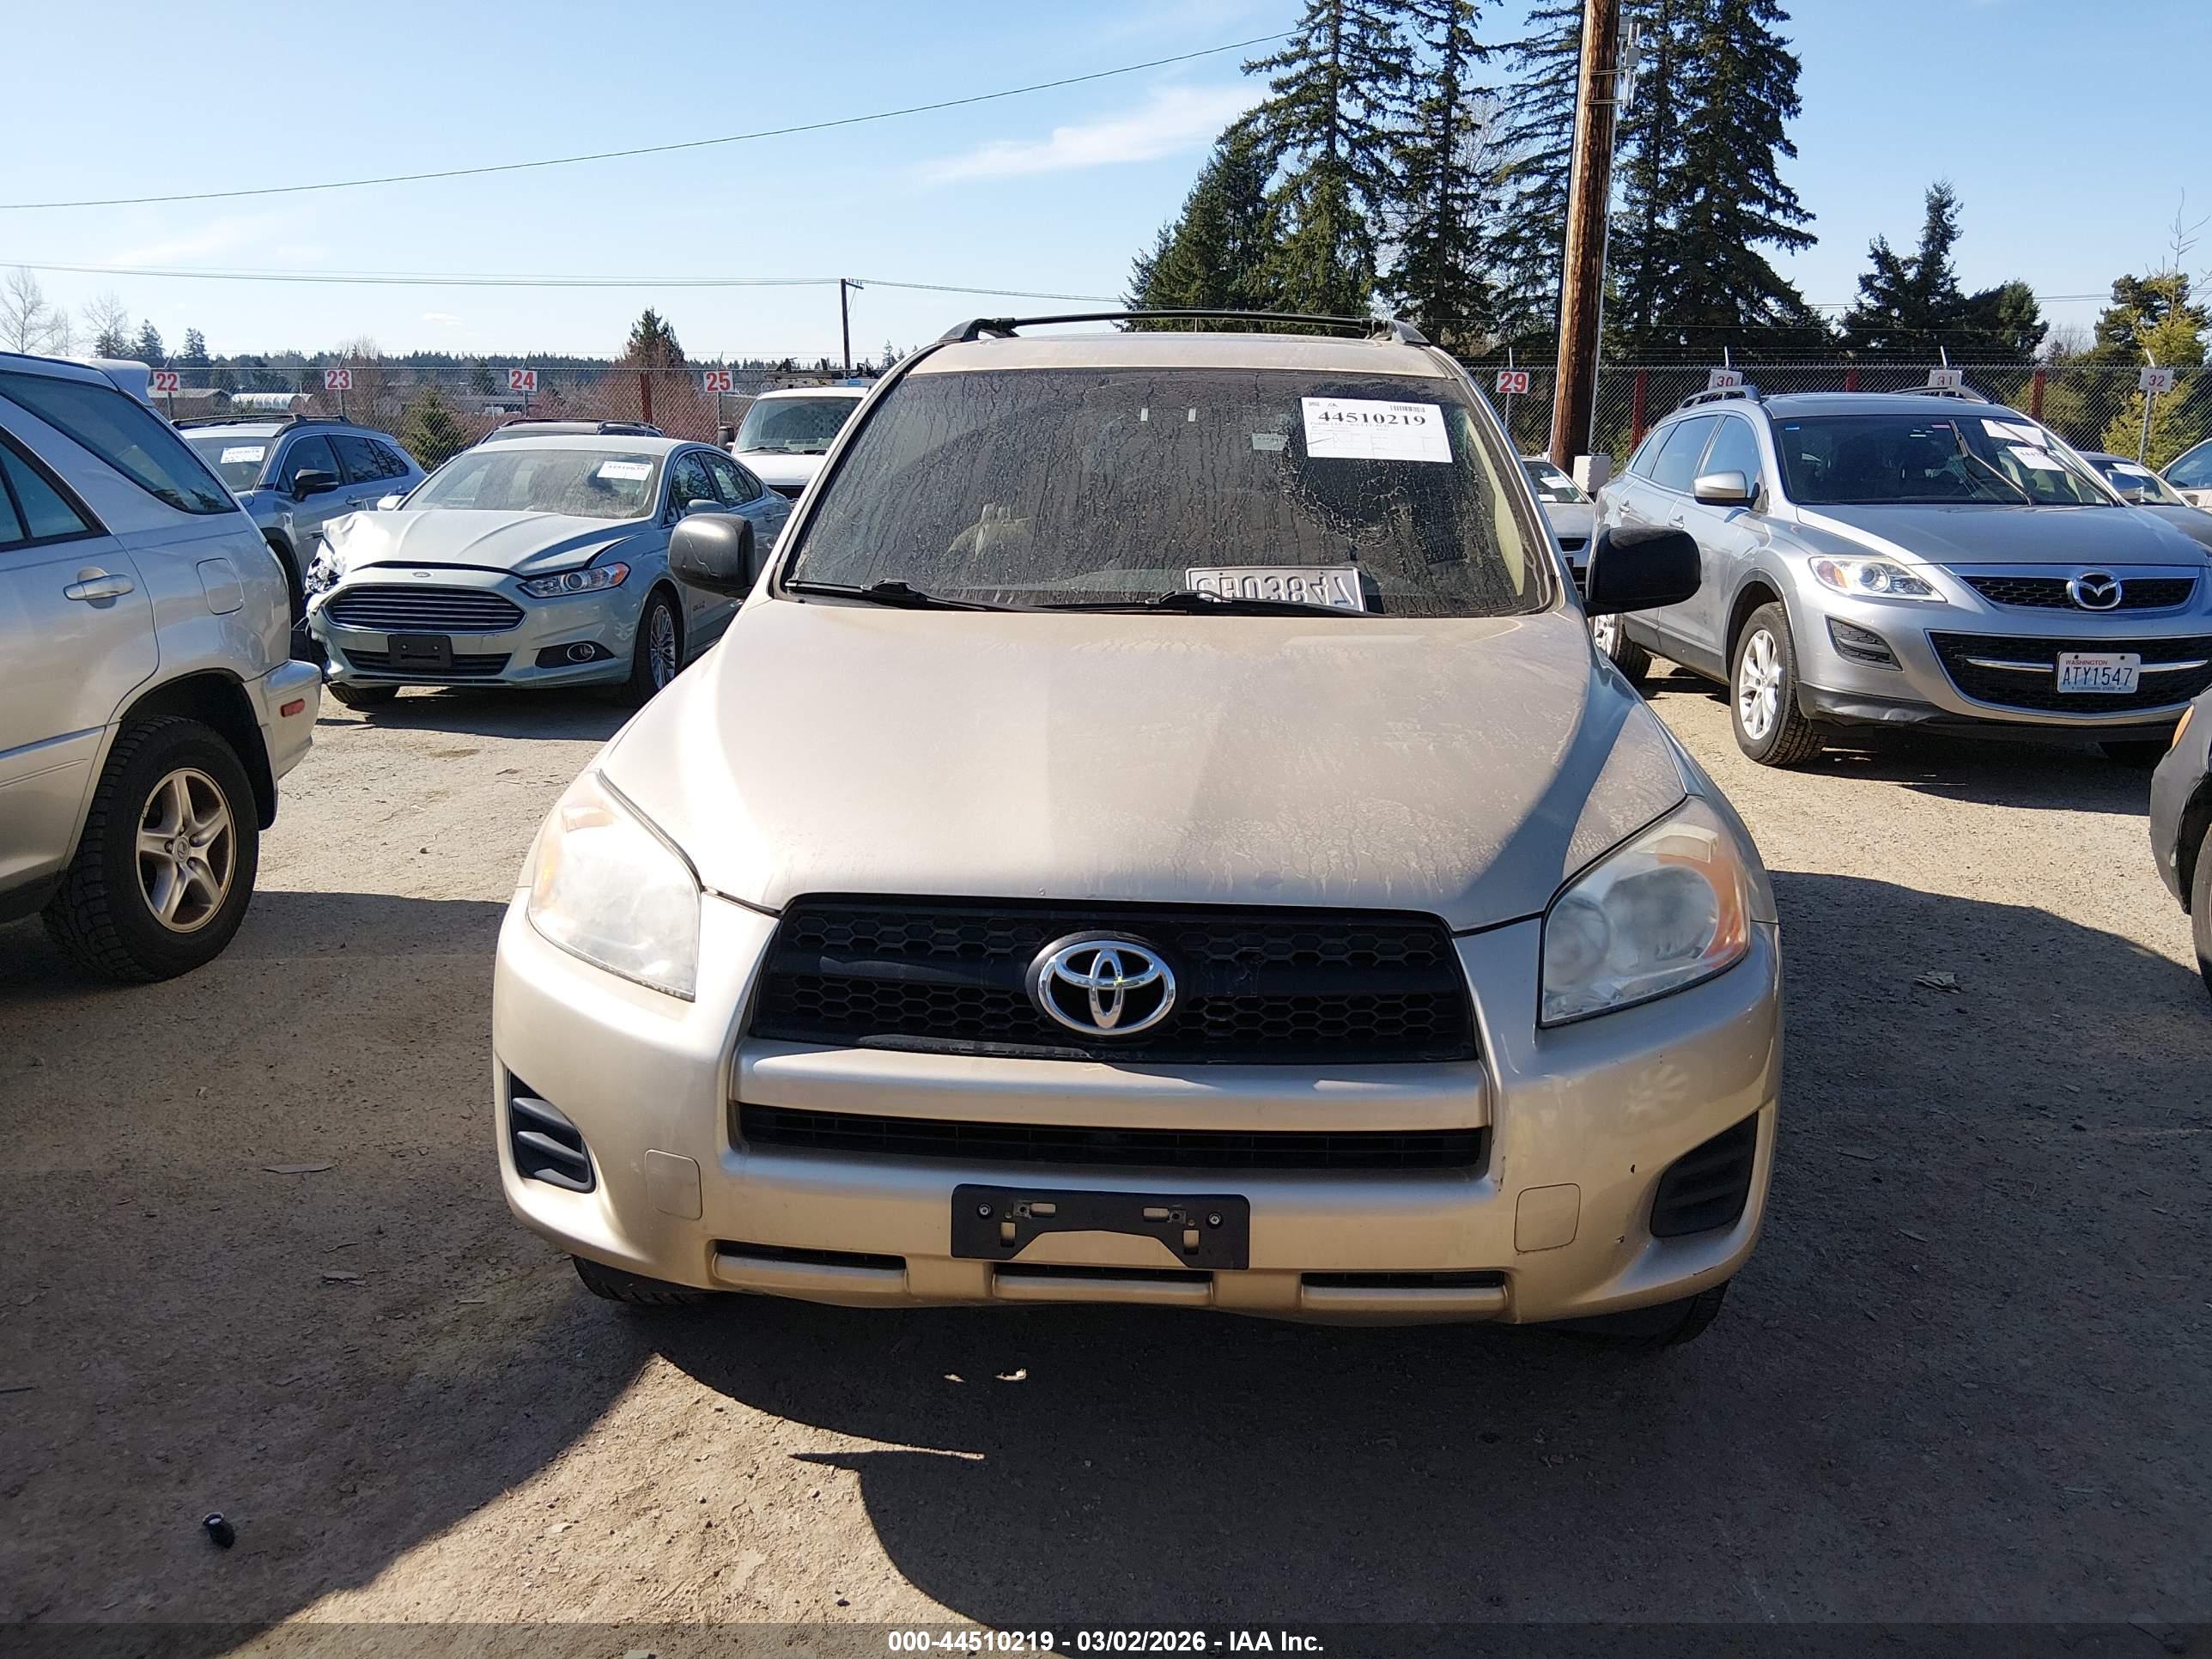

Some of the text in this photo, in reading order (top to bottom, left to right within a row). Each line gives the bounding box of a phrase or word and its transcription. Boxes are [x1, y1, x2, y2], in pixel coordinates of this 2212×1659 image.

[155, 373, 179, 392] 22
[327, 370, 350, 389] 23
[511, 370, 535, 390] 24
[706, 372, 731, 392] 25
[1498, 372, 1527, 392] 29
[1717, 375, 1734, 387] 30
[2148, 374, 2165, 387] 32
[1318, 410, 1426, 426] 44510219
[2063, 666, 2133, 686] ATY1547
